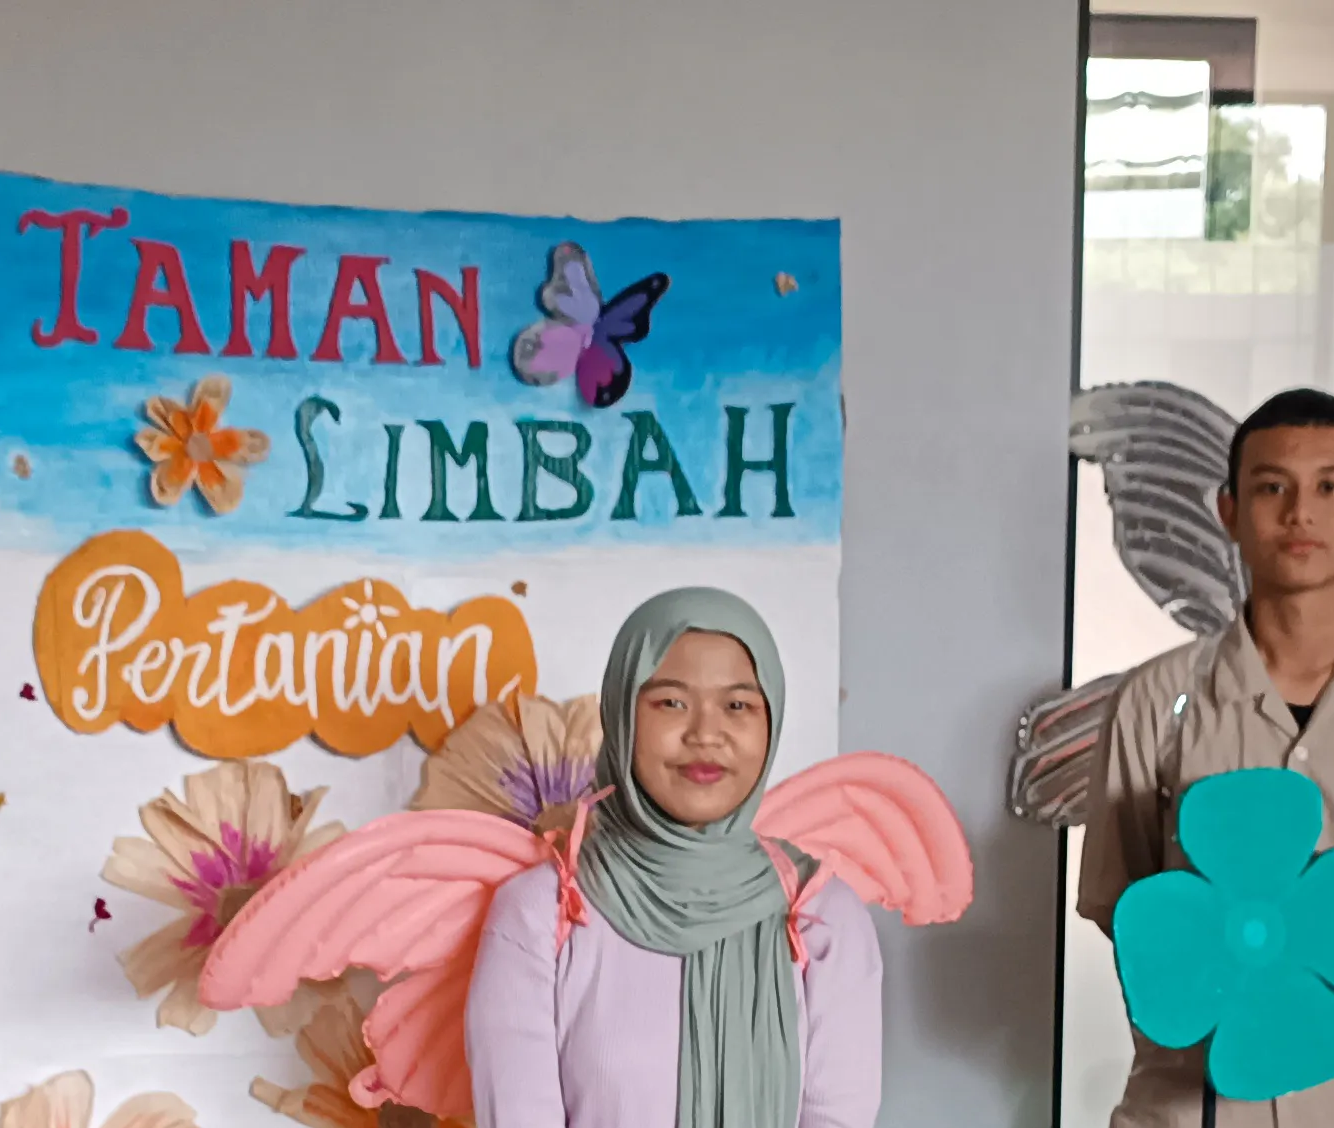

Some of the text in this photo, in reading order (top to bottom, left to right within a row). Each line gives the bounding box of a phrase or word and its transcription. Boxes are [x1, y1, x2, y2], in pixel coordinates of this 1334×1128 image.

[16, 207, 484, 369] TAMAN
[285, 394, 797, 523] LIMBAH
[71, 564, 523, 730] Pertanian
